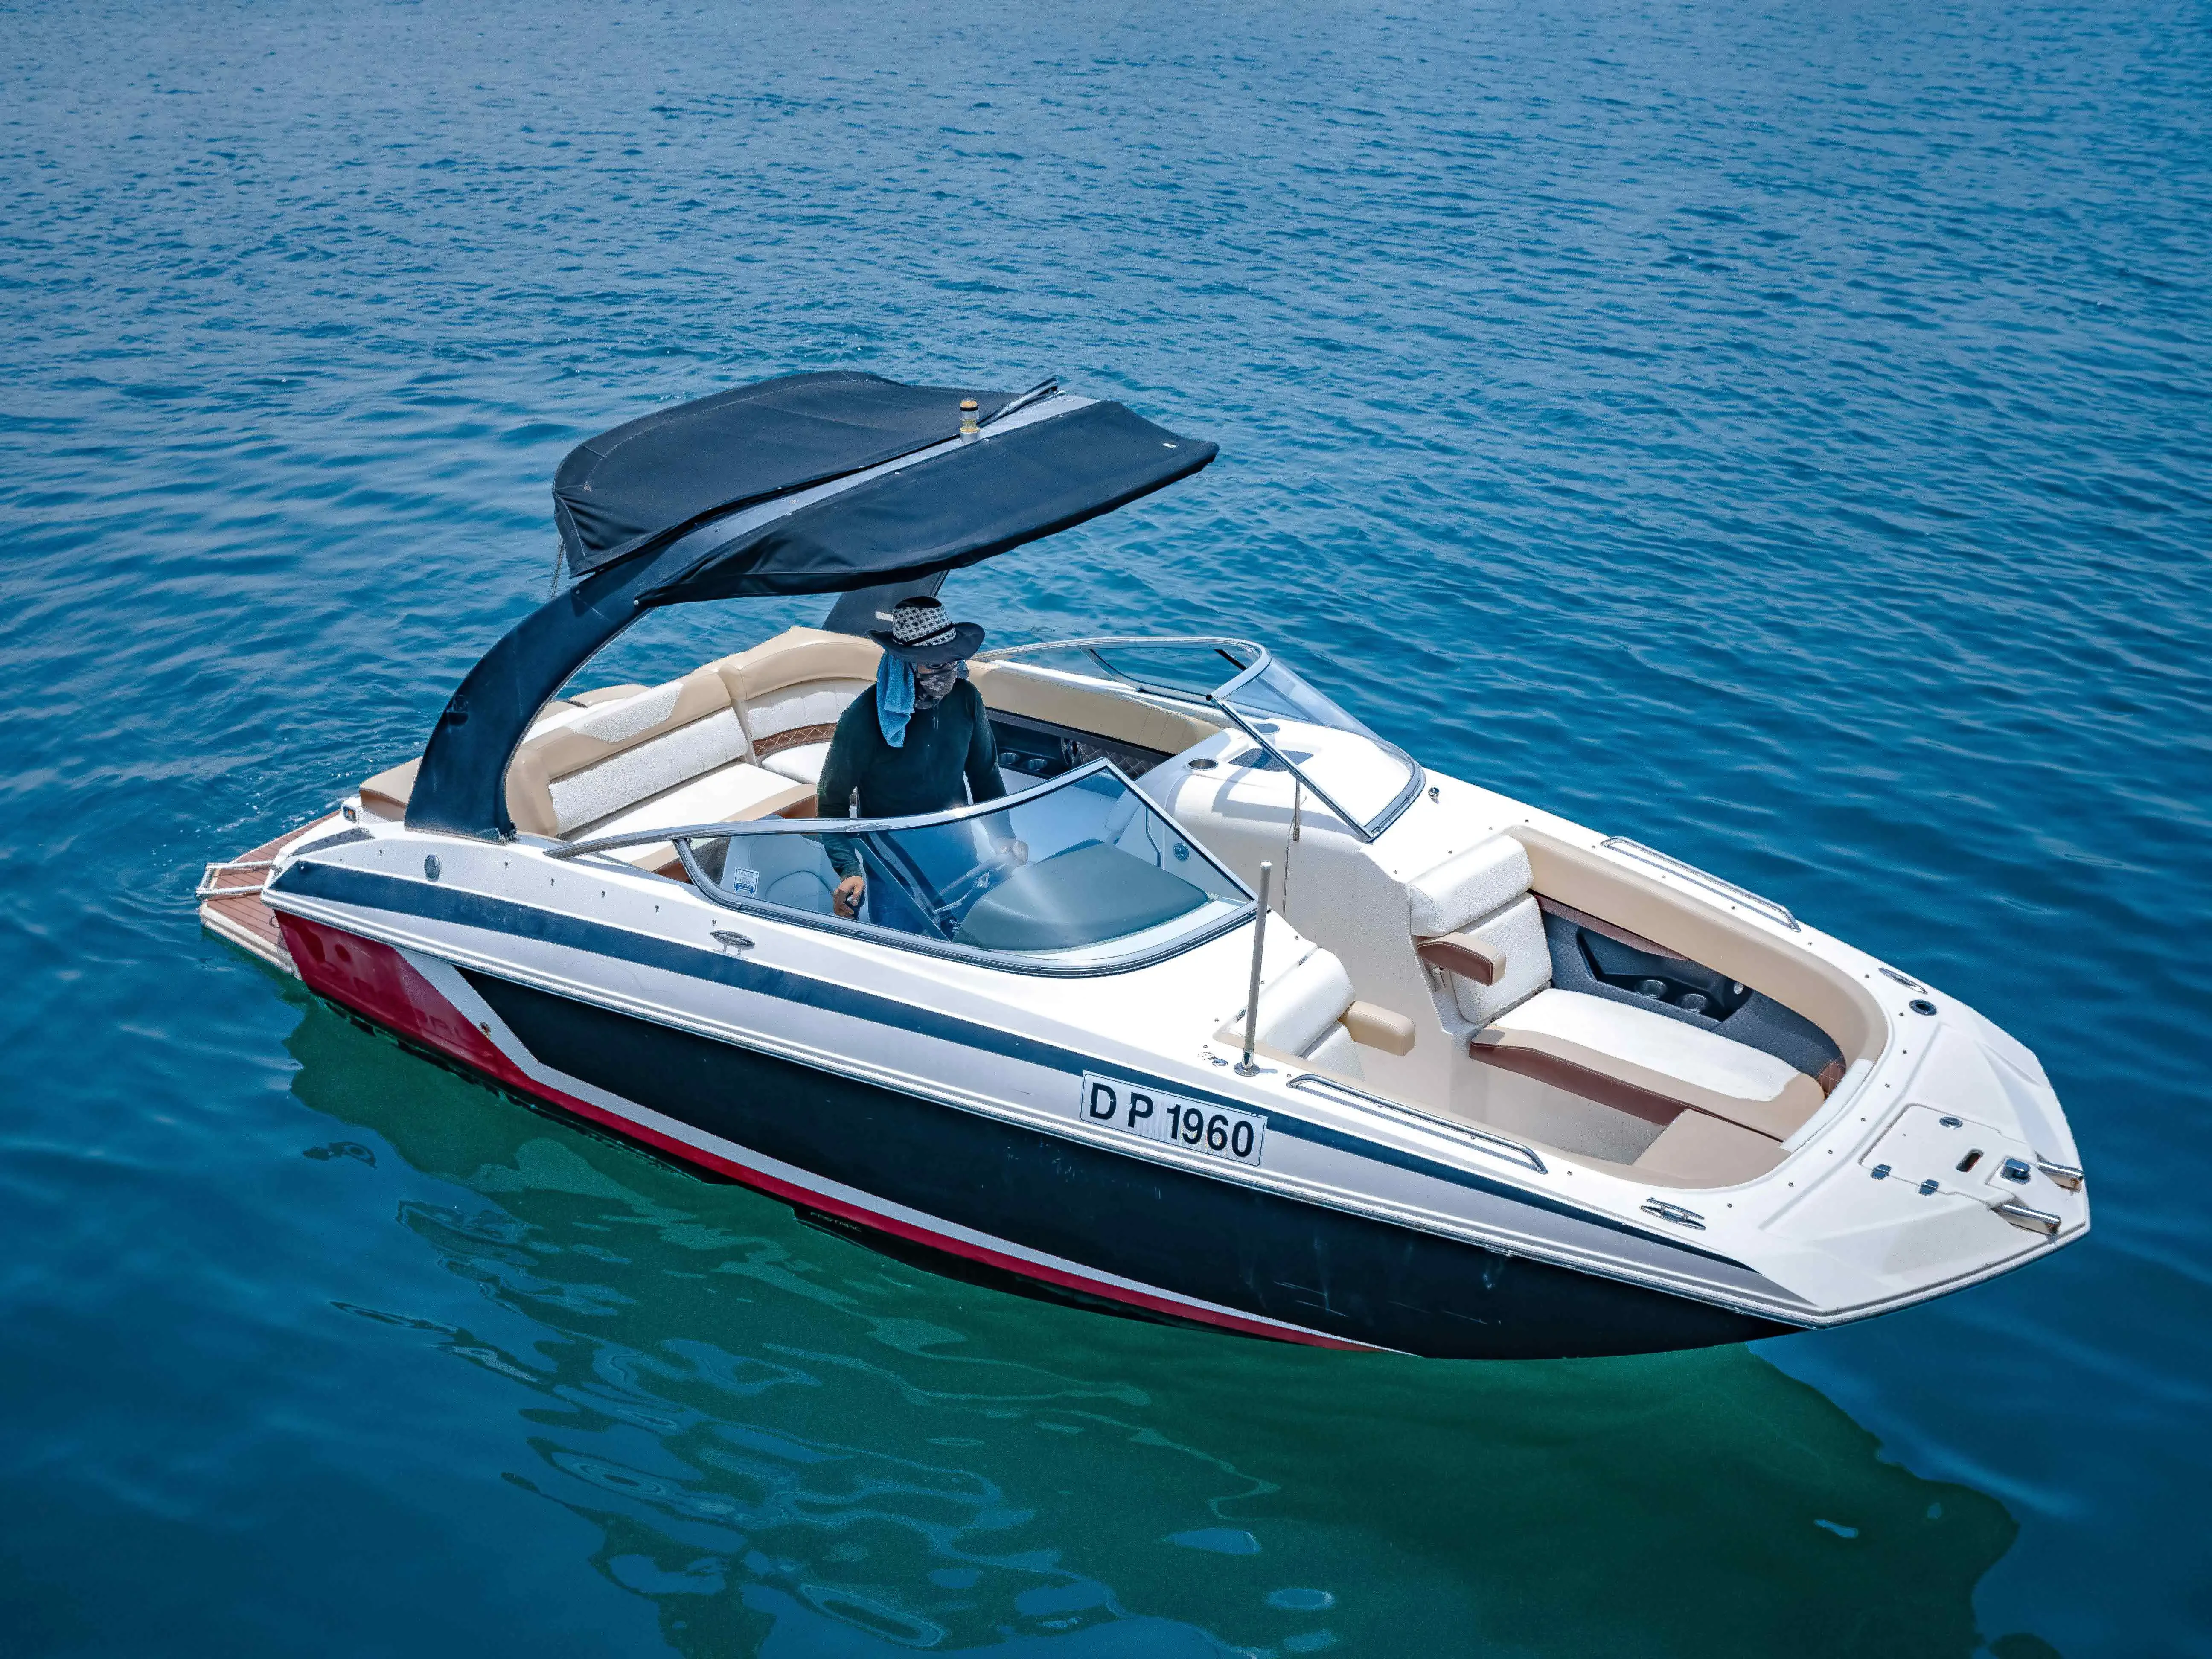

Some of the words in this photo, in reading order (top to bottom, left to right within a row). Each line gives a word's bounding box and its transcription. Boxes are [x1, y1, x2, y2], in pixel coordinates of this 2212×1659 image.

[1089, 1082, 1117, 1120] D
[1127, 1092, 1154, 1128] P
[1167, 1104, 1254, 1158] 1960
